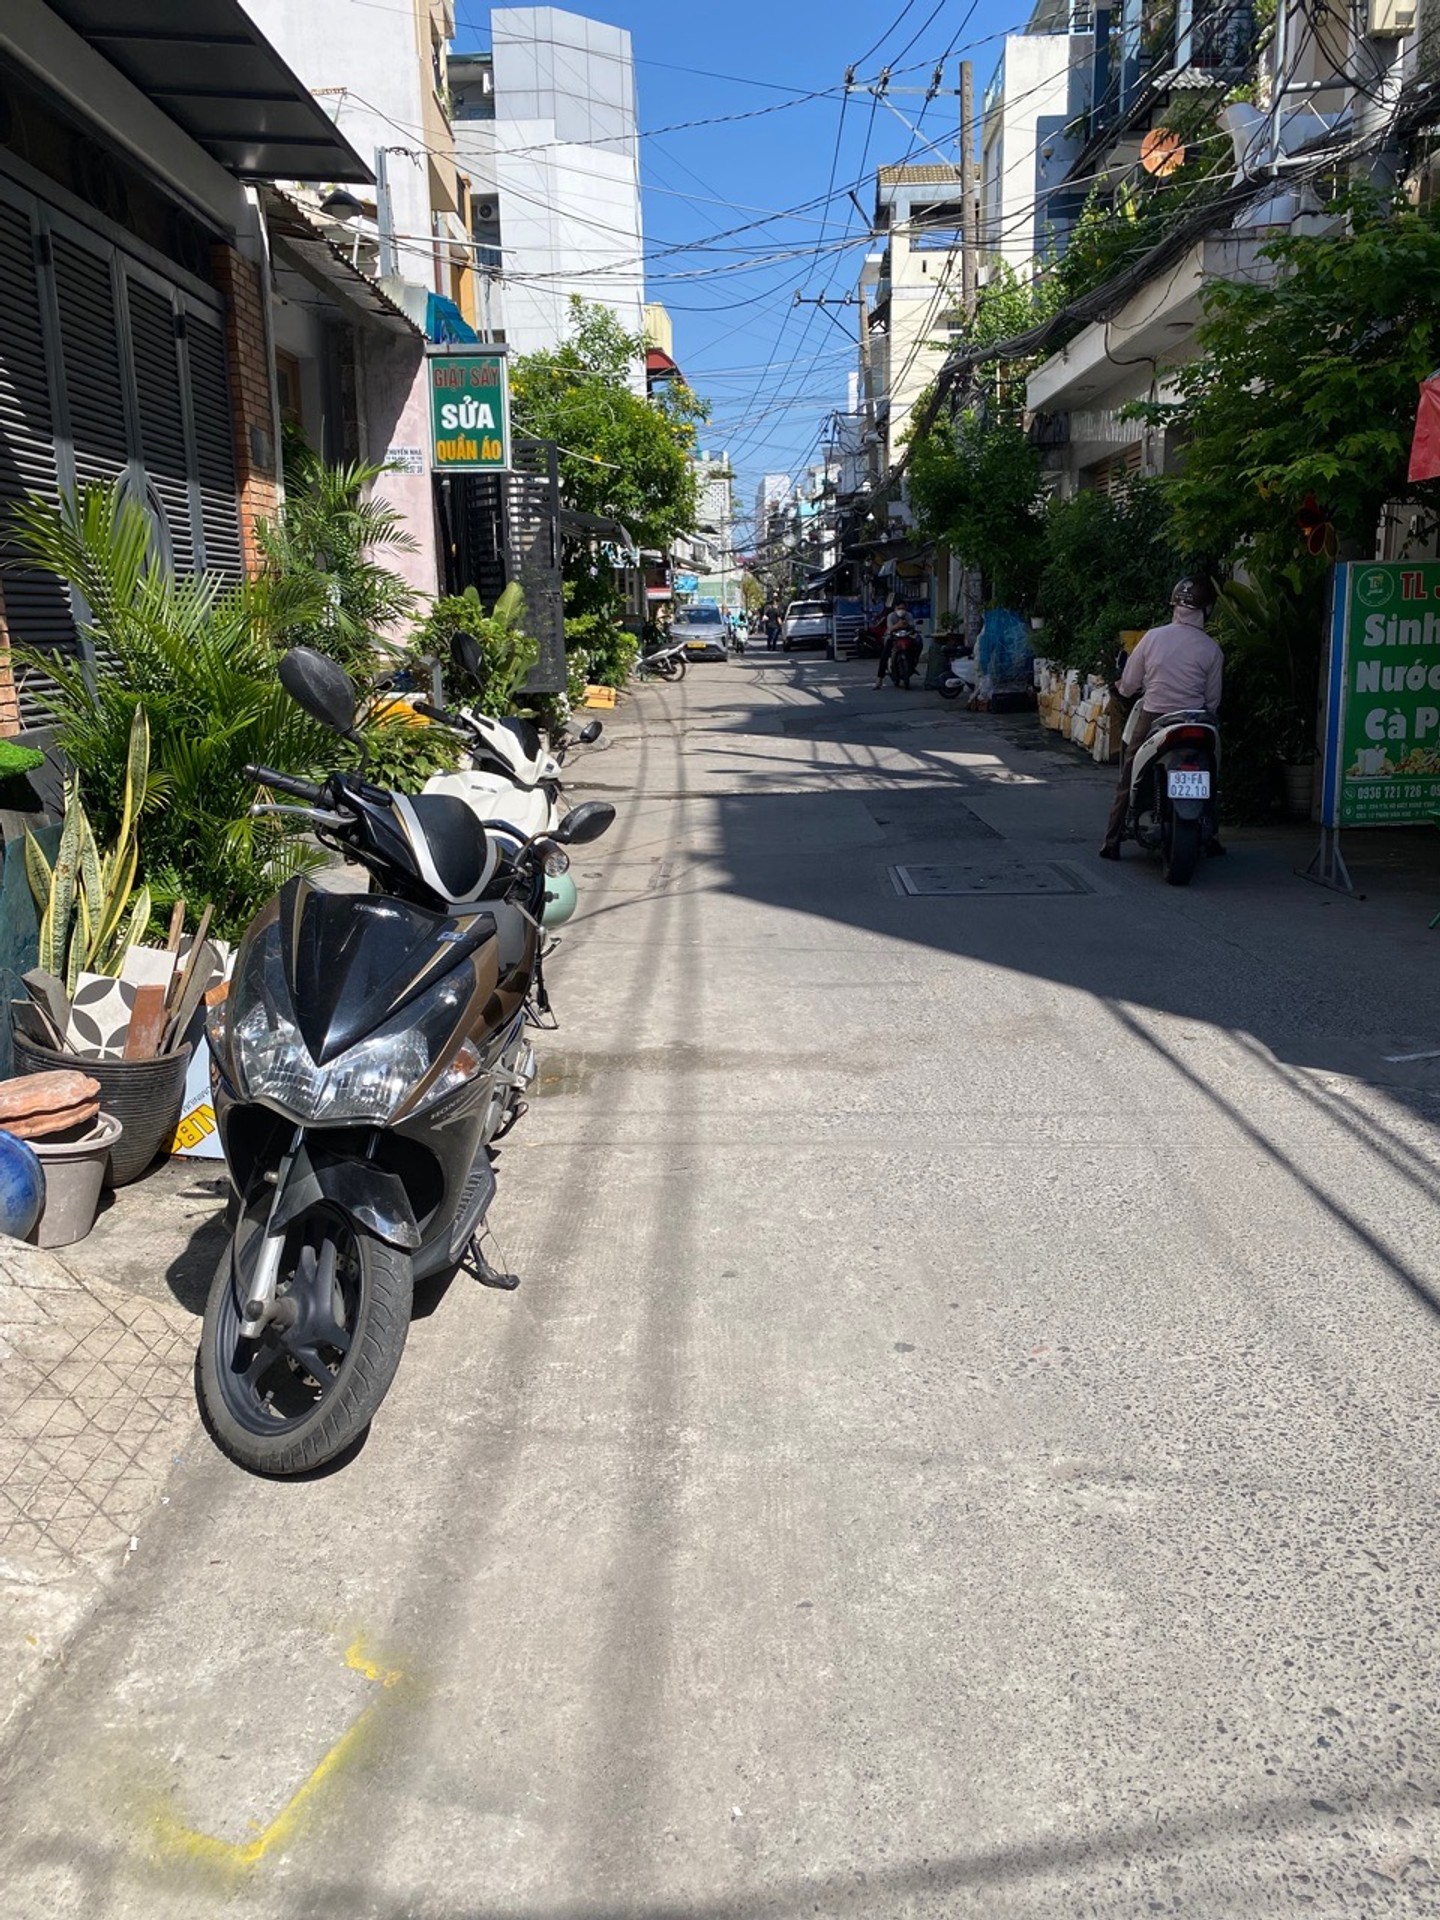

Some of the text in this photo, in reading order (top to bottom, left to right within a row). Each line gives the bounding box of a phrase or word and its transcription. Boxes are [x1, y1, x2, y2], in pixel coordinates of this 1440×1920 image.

[470, 360, 500, 387] SẤY
[441, 395, 496, 430] SỬA
[436, 433, 502, 462] QUẦN ÁO
[1400, 571, 1428, 600] TL
[1363, 612, 1440, 647] Sinh
[1356, 659, 1440, 693] Nước
[1365, 707, 1440, 740] Cà P
[1170, 785, 1208, 797] 022.10
[1357, 786, 1381, 799] 0936
[1384, 785, 1400, 799] 721
